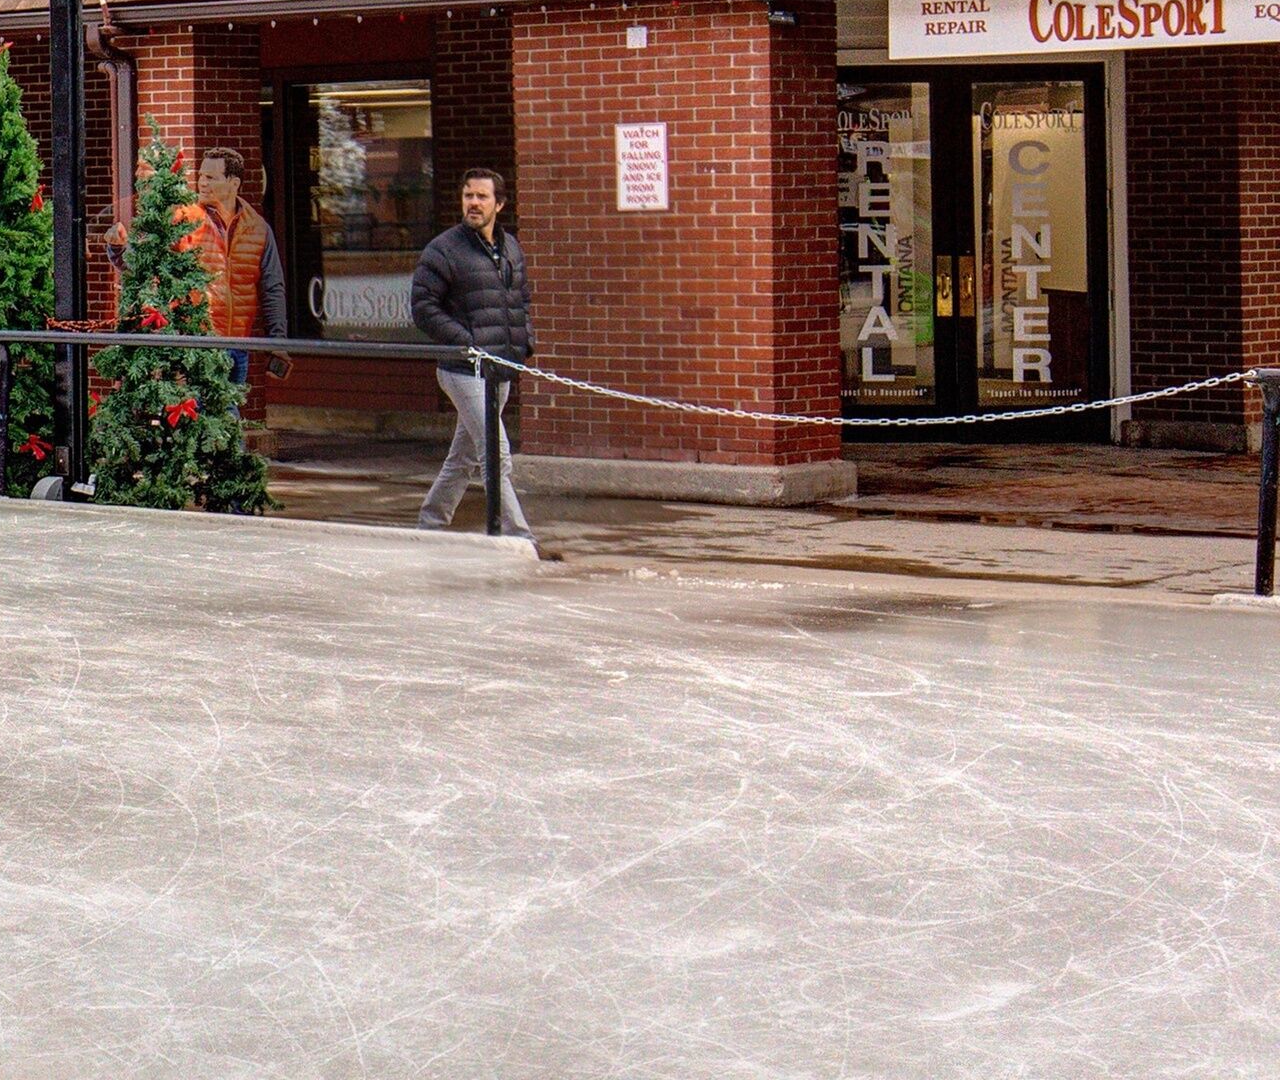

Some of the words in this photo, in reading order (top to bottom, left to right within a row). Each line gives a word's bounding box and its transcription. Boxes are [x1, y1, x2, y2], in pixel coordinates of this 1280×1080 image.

[921, 0, 990, 16] RENTAL
[924, 20, 987, 36] REPAIR
[622, 129, 659, 139] WATCH
[629, 140, 648, 149] FOR
[621, 150, 662, 160] FALLING
[626, 161, 657, 171] SNOW
[623, 173, 645, 182] AND
[646, 173, 662, 182] ICE
[626, 183, 655, 193] FROM
